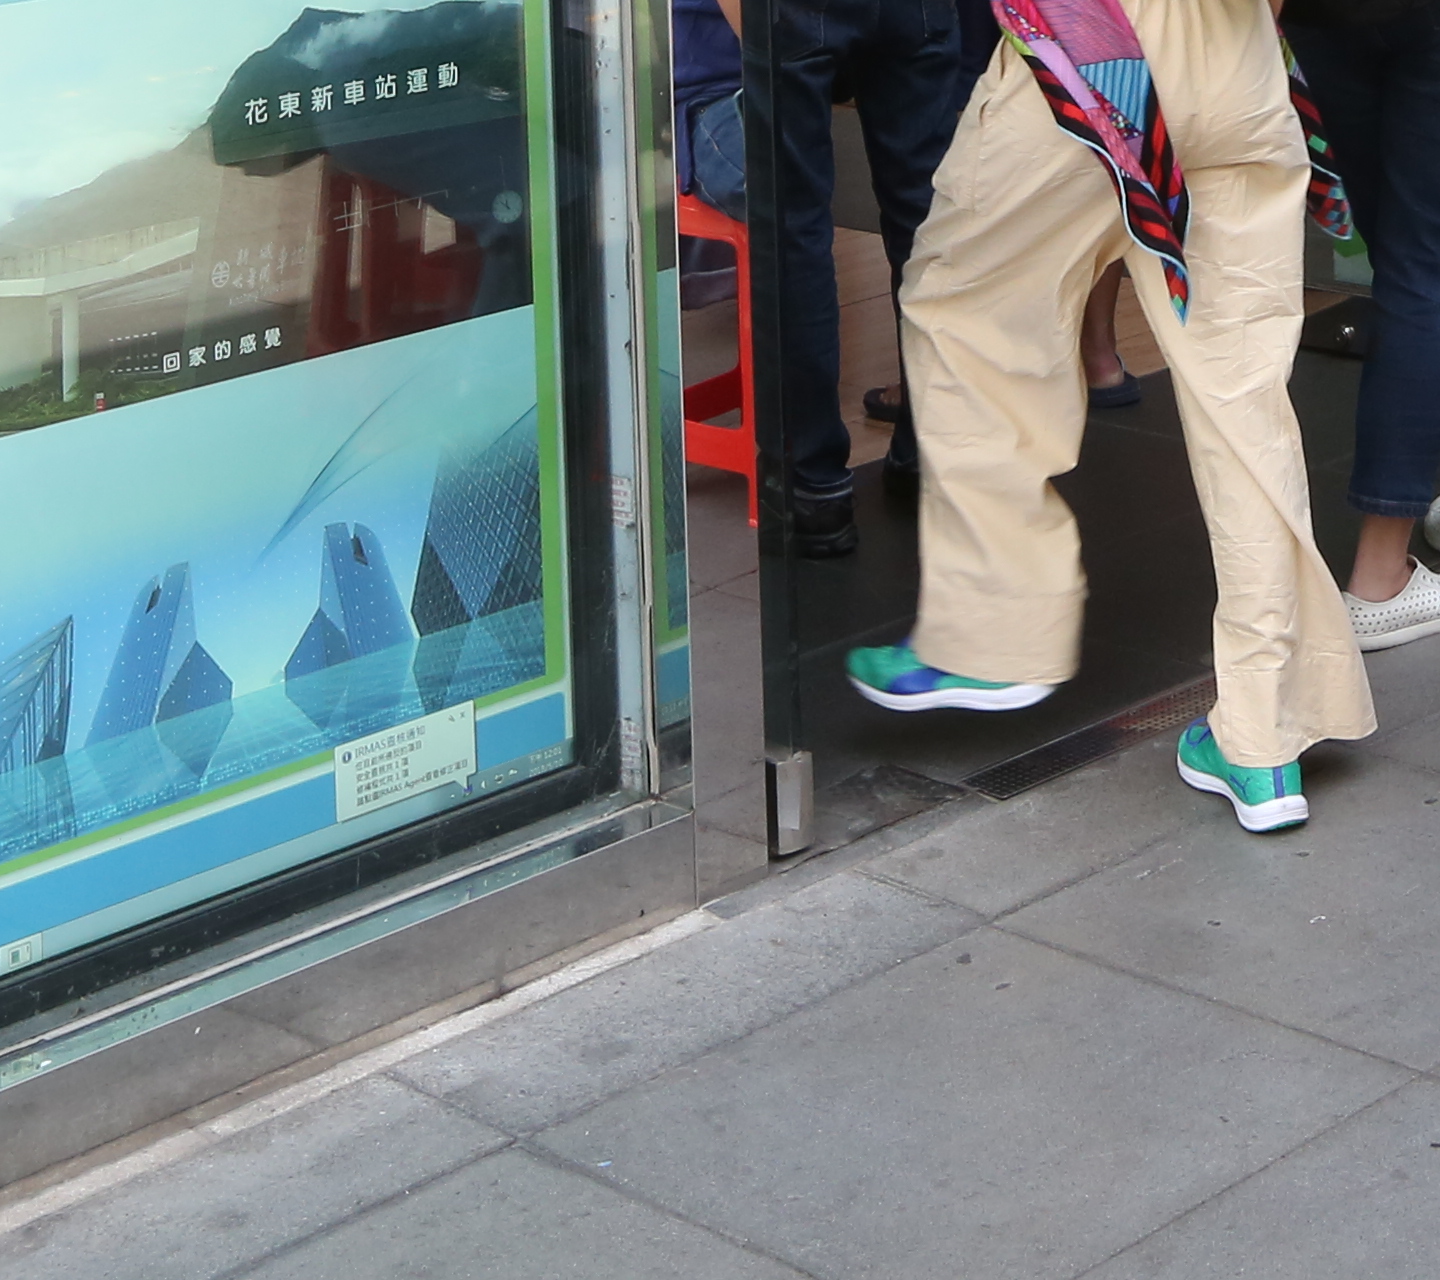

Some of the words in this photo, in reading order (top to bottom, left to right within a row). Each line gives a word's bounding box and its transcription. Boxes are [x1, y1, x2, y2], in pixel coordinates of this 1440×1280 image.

[244, 61, 461, 128] 花東新車站運動
[162, 326, 283, 374] 回家的感覺
